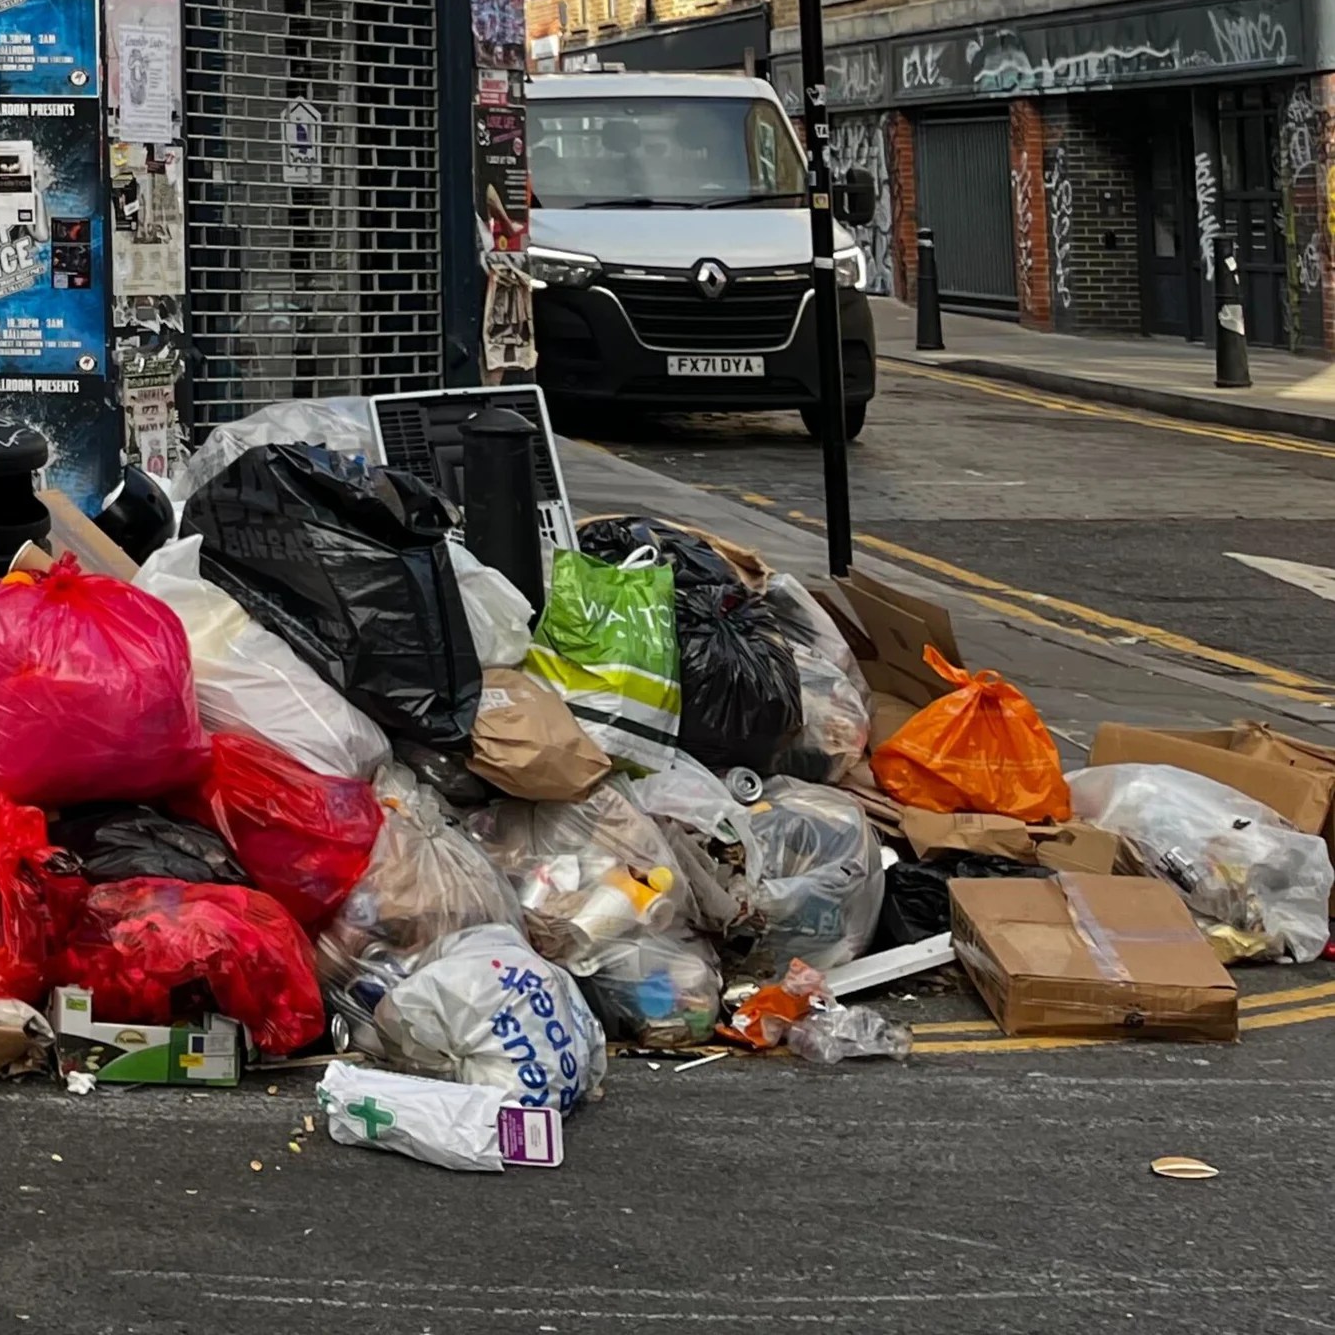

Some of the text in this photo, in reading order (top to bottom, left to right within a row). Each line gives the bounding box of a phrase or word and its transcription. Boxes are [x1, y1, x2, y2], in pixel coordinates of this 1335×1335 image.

[31, 103, 75, 117] PRESENTS
[677, 358, 753, 373] FX71 DYA
[35, 380, 79, 393] PRESENTS
